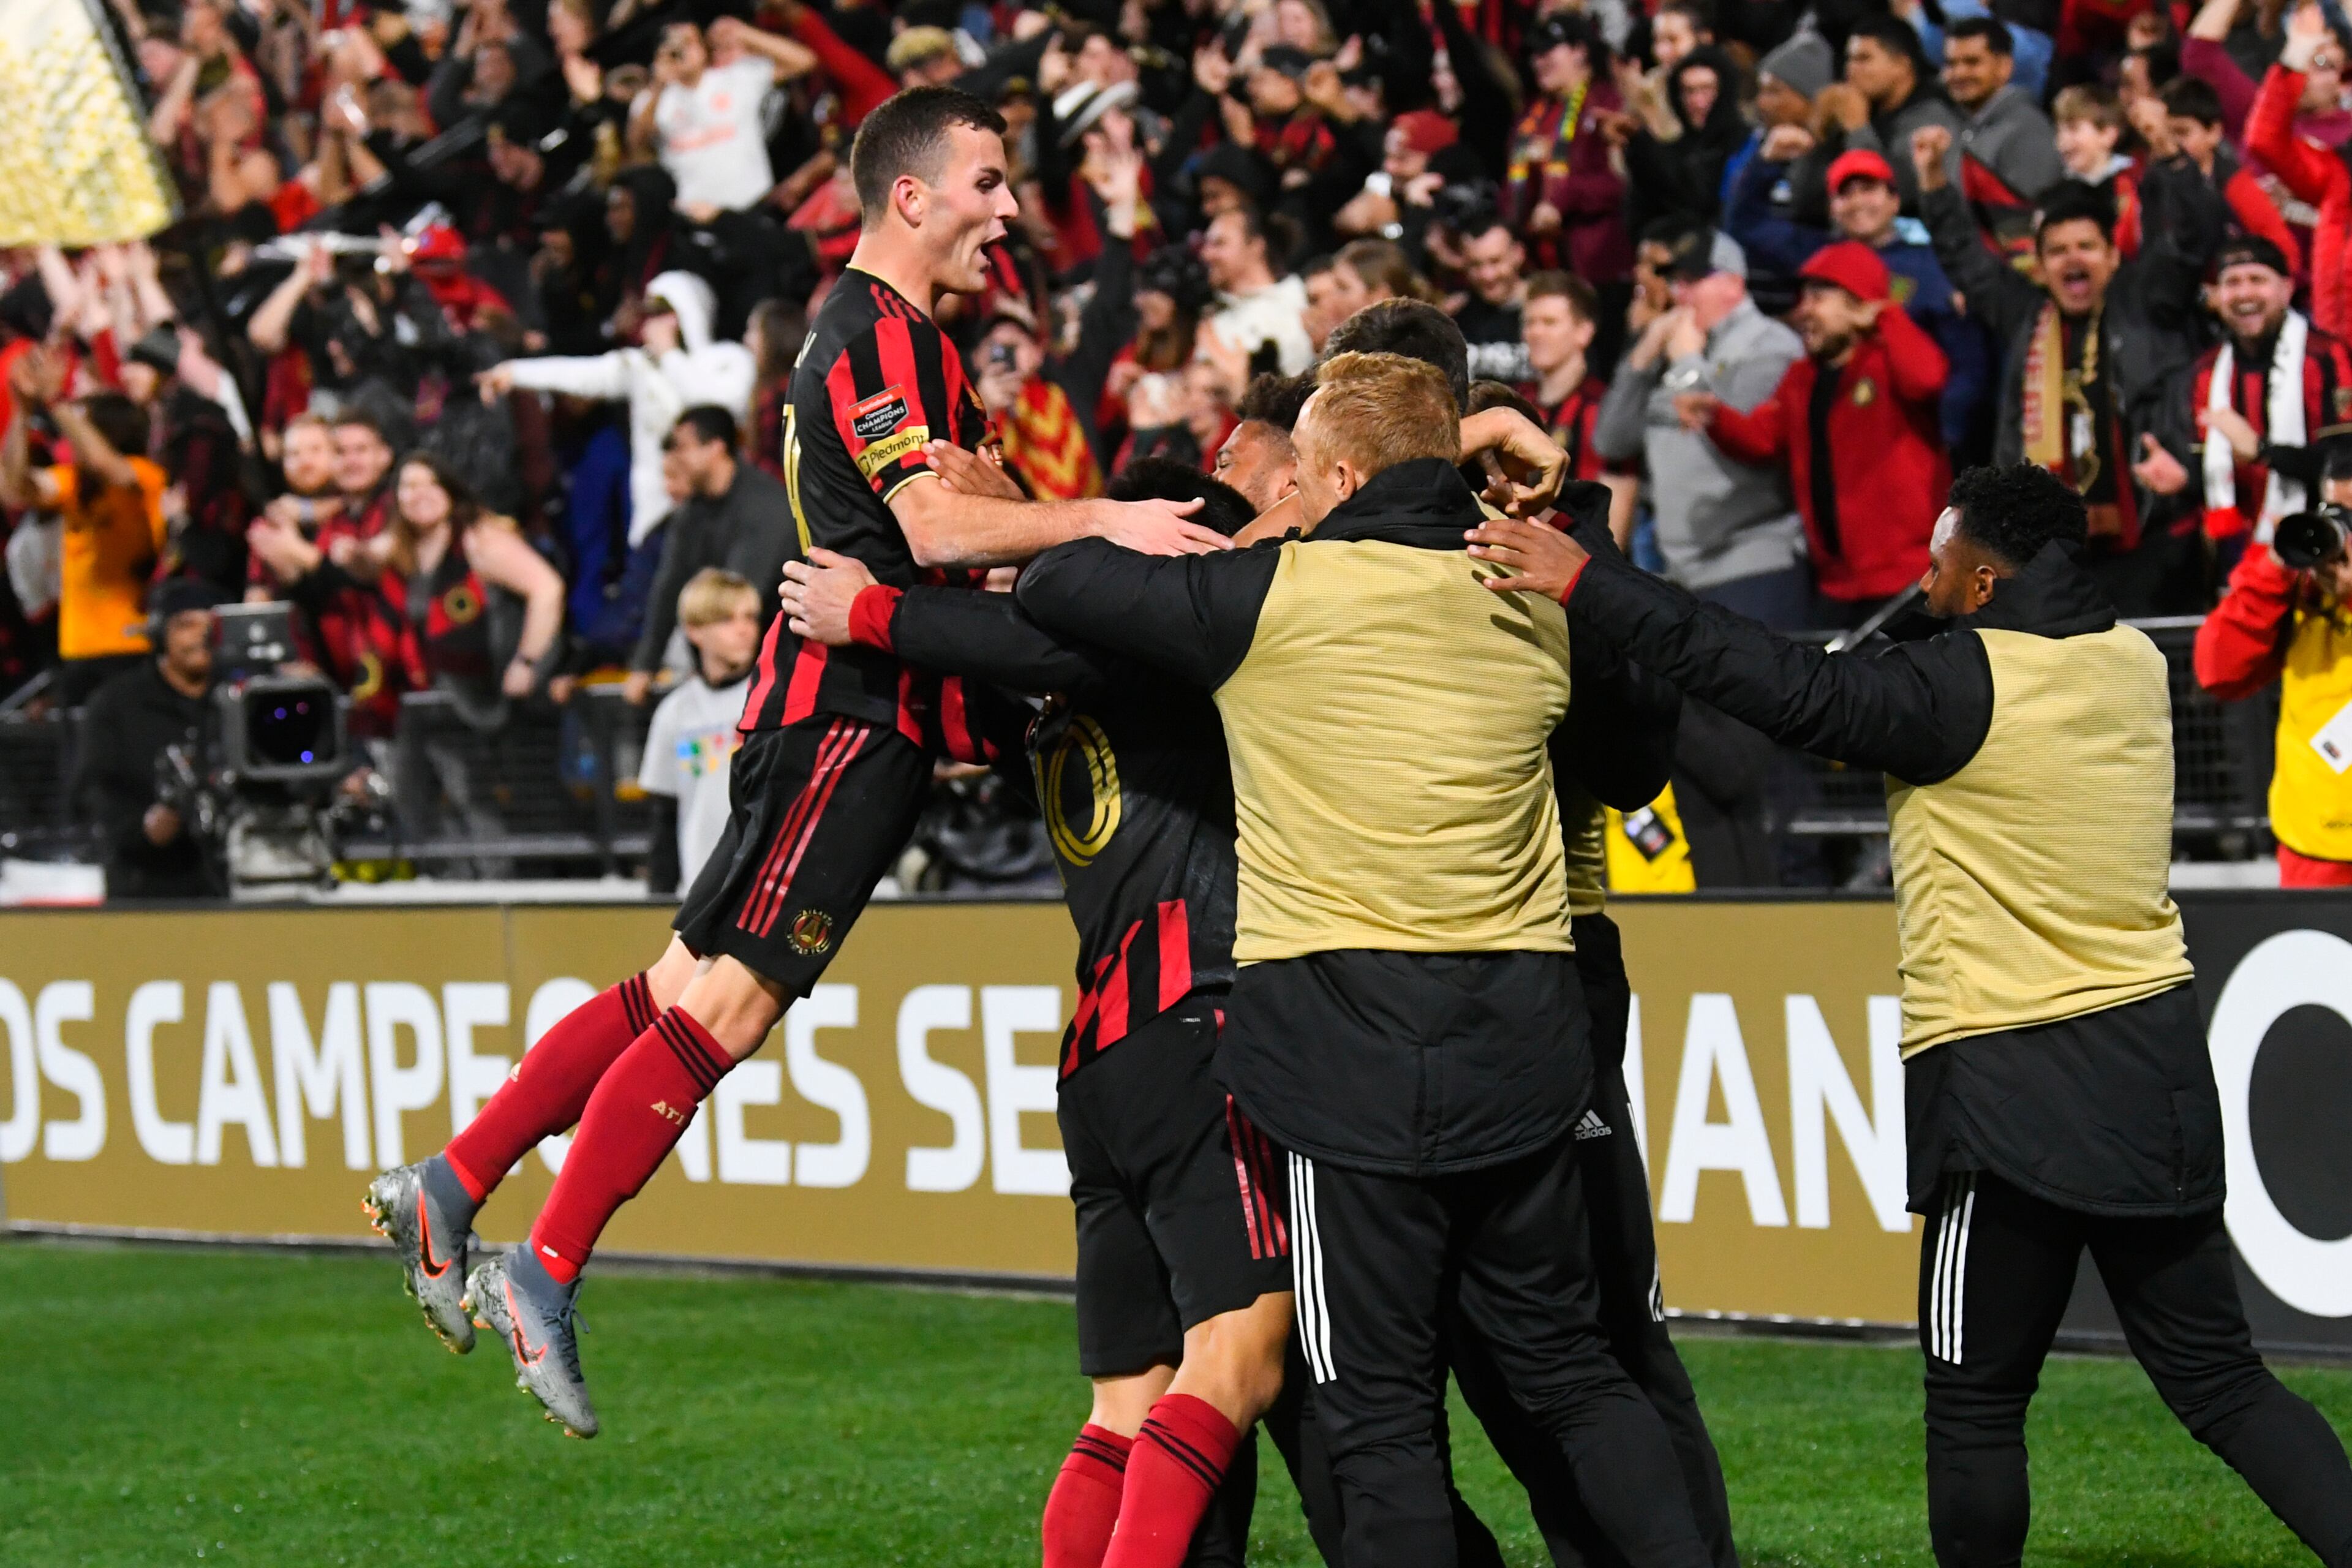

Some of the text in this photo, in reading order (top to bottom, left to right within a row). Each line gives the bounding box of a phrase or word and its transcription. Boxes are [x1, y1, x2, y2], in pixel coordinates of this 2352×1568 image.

[857, 405, 905, 432] CHAMPIONS
[872, 420, 893, 432] LEAGUE
[869, 434, 925, 466] Piedmont
[126, 978, 872, 1189] CAMPEES
[895, 985, 1073, 1197] SE
